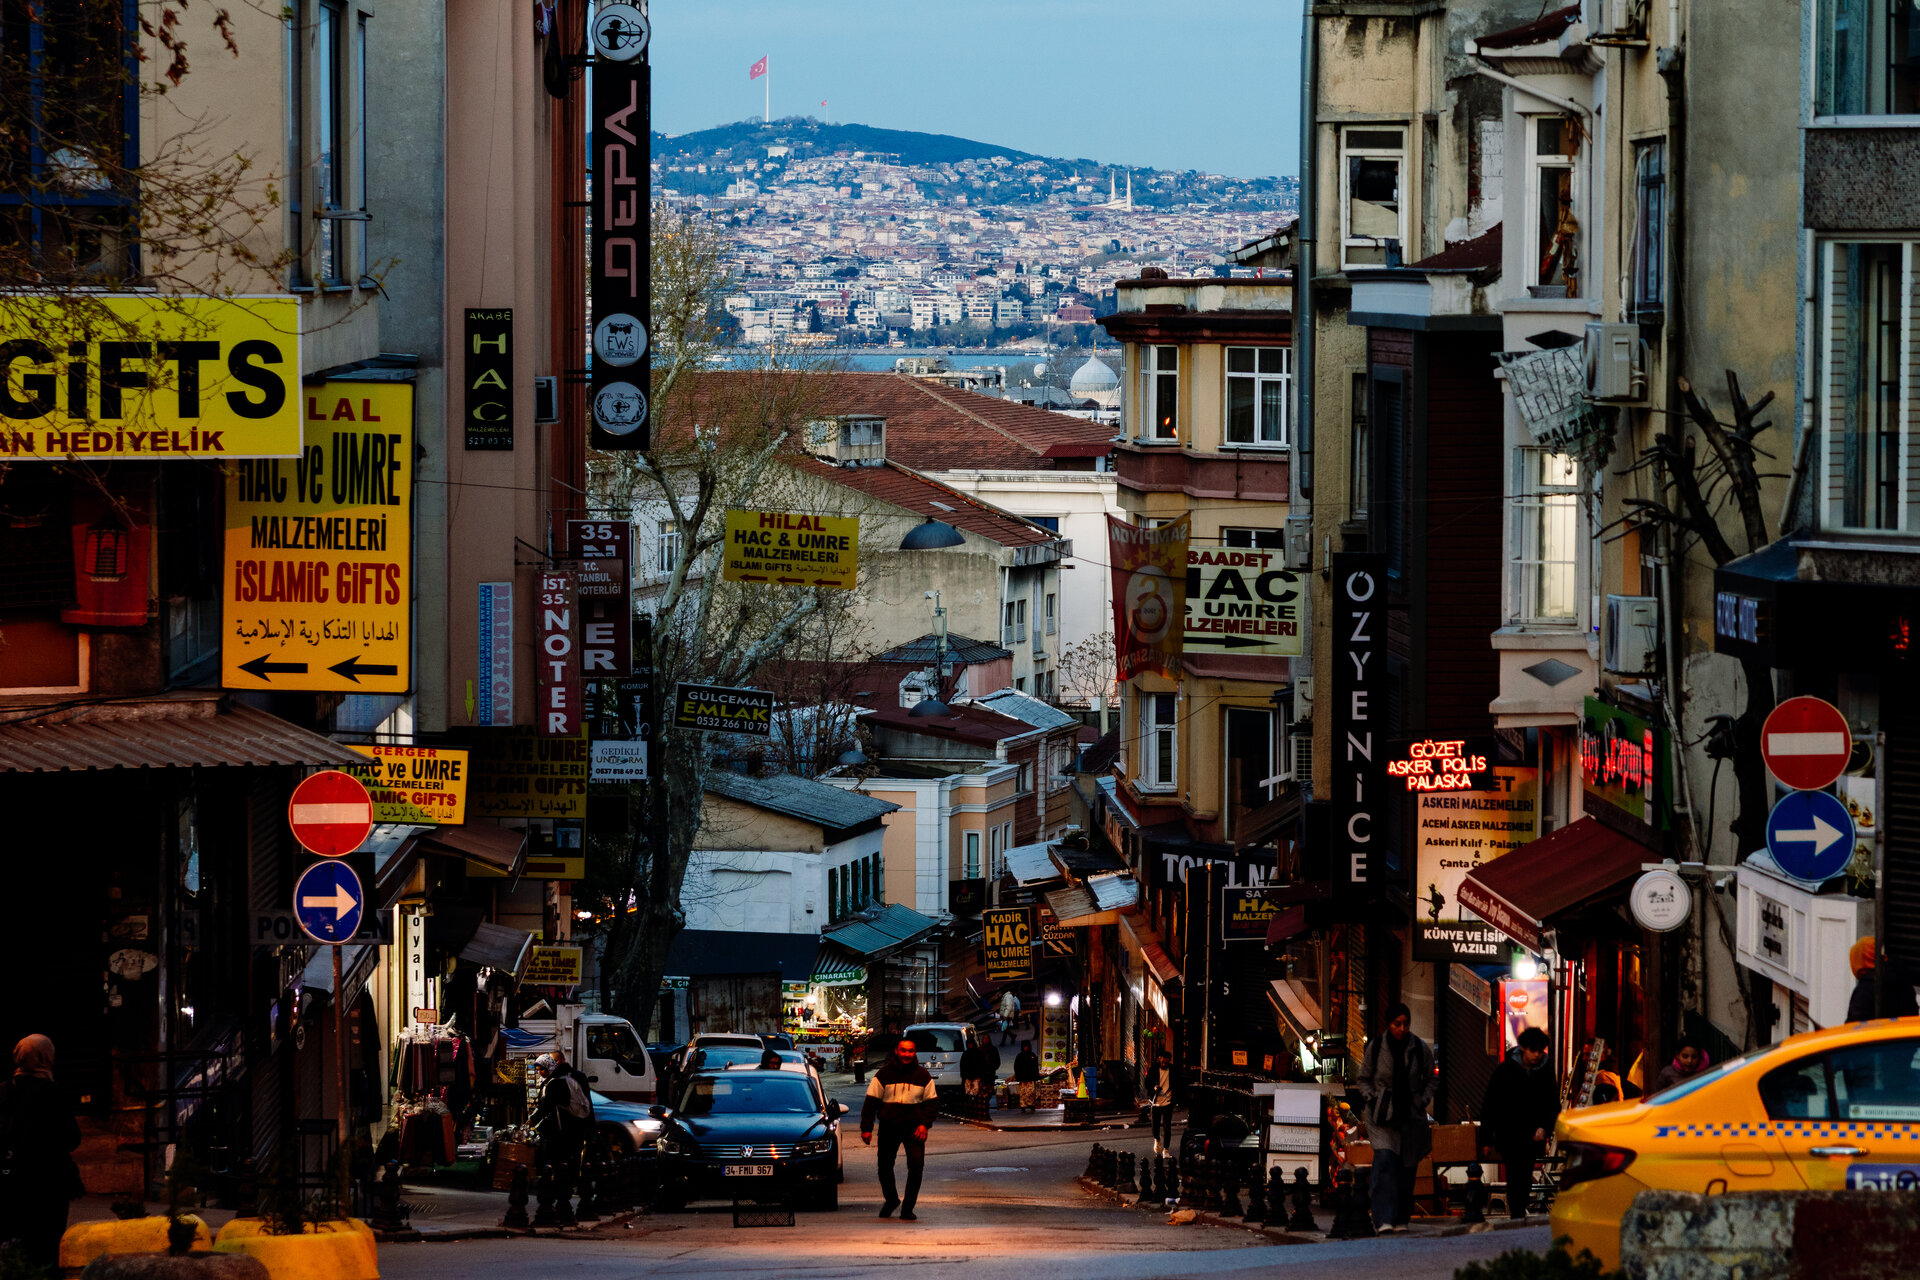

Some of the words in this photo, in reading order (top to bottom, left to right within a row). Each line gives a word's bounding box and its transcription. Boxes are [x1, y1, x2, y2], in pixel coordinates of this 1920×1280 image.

[470, 311, 510, 321] AKABE
[472, 333, 507, 421] HAC
[1512, 348, 1584, 423] HA
[46, 426, 225, 453] HEDİYELİK
[297, 445, 323, 504] ve
[332, 432, 401, 506] UMRE
[251, 513, 387, 551] MALZEMELERİ
[580, 524, 620, 540] 35.
[734, 530, 772, 545] HAC
[778, 532, 791, 547] &
[798, 534, 850, 550] UMRE
[583, 562, 599, 571] T.C.
[1187, 551, 1273, 567] SAADET
[542, 593, 570, 605] 35.
[1205, 602, 1296, 619] UMRE
[362, 620, 400, 646] الهدايا
[544, 609, 571, 734] NOTER
[687, 690, 768, 707] GÜLCEMAL
[683, 700, 769, 721] EMLAK
[696, 716, 720, 727] 0532
[722, 719, 740, 729] 266
[743, 720, 754, 730] 10
[757, 722, 769, 731] 79
[1346, 571, 1375, 882] ÖZYENİCE
[372, 746, 437, 757] GERGER
[1409, 739, 1465, 758] GÖZET
[388, 762, 406, 778] ve
[412, 759, 462, 780] UMRE
[1387, 760, 1434, 775] ASKER
[1442, 755, 1487, 773] POLİS
[362, 779, 444, 790] MALZEMELERİ
[1406, 773, 1472, 791] PALASKA
[1422, 817, 1450, 829] ACEMİ
[1451, 820, 1481, 830] ASKER
[1482, 821, 1533, 832] MALZEMESİ
[1425, 837, 1458, 847] Askeri
[1460, 837, 1482, 847] Kılıf
[1440, 859, 1469, 869] Çanta
[1239, 898, 1281, 912] HA
[991, 911, 1022, 924] KADİR
[985, 923, 1029, 946] HAC
[1424, 927, 1463, 940] KÜNYE
[1465, 930, 1482, 941] VE
[987, 950, 998, 959] ve
[1001, 946, 1030, 958] UMRE
[1452, 943, 1497, 955] YAZILIR
[987, 957, 1030, 969] MALZEMELERİ
[726, 1166, 735, 1175] 34
[738, 1166, 753, 1175] FMU
[757, 1166, 771, 1175] 967
